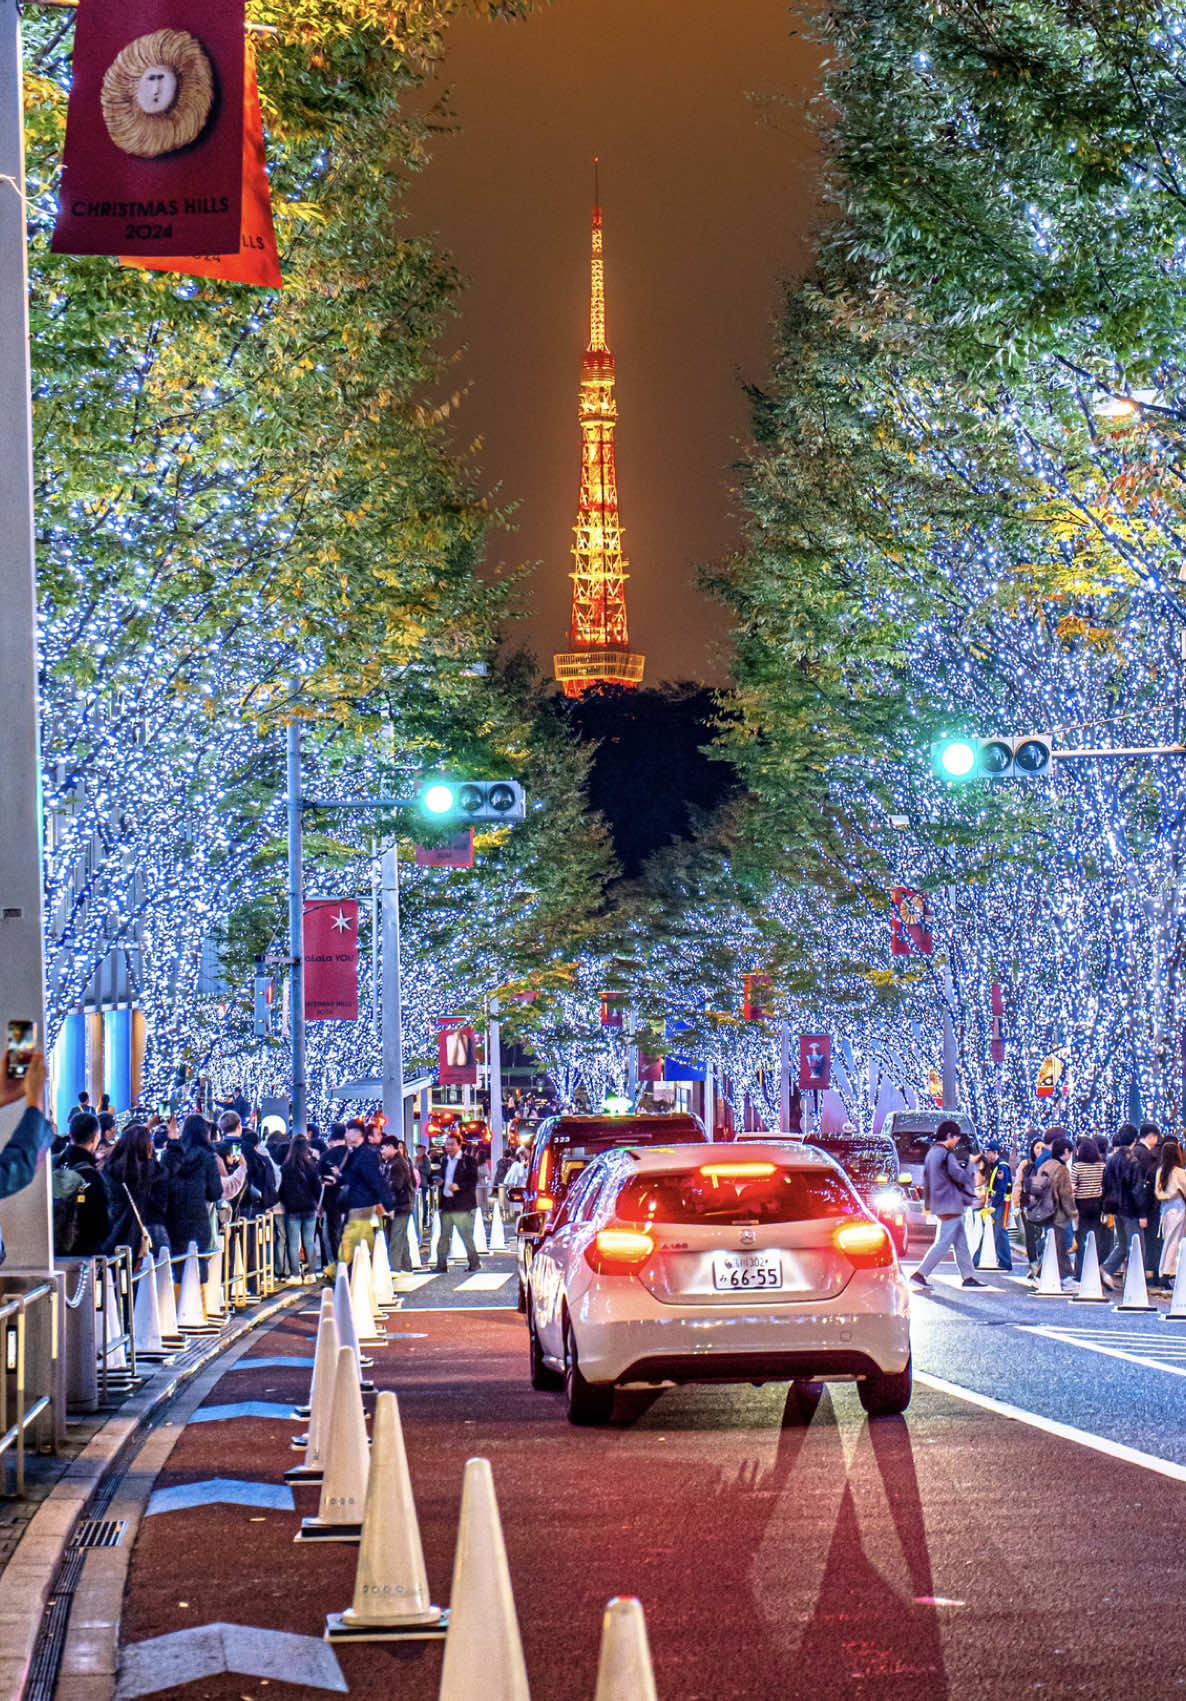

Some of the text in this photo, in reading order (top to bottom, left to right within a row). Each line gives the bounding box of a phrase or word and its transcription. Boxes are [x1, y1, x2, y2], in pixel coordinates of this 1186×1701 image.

[71, 197, 229, 218] CHRISTMAS HILLS
[125, 224, 173, 240] 2024
[242, 233, 265, 250] LLS
[730, 1268, 777, 1286] 66-55
